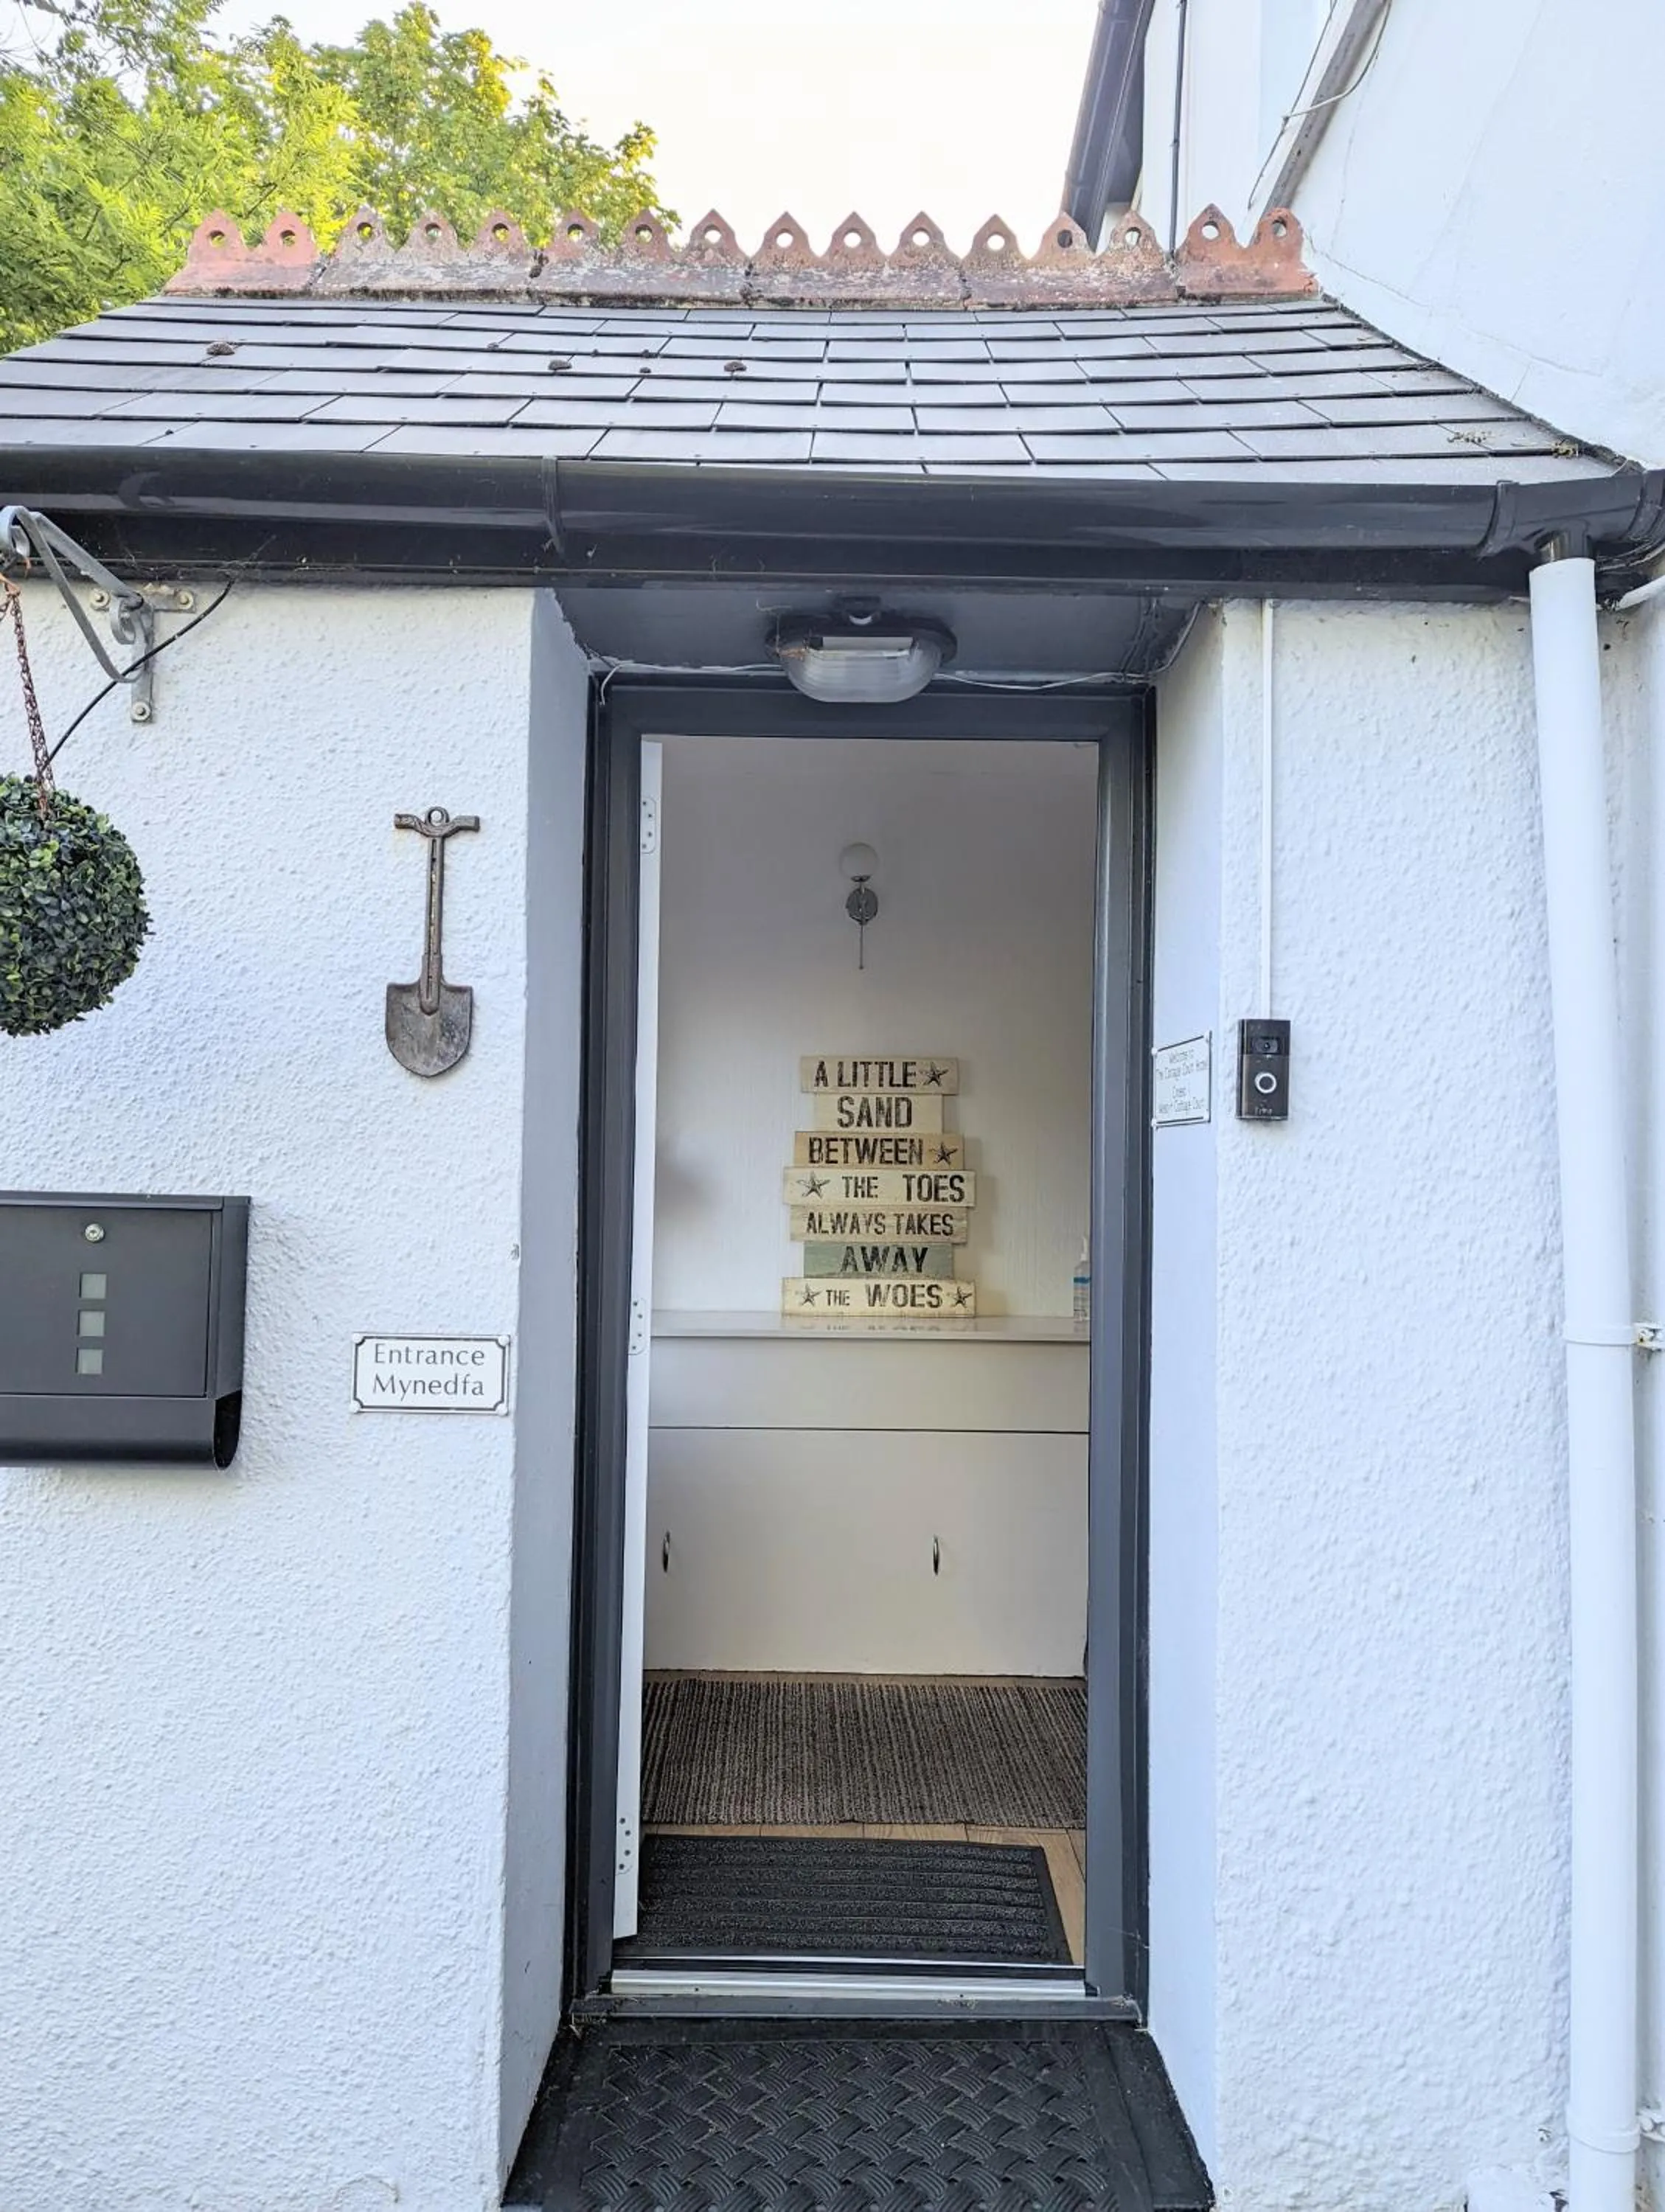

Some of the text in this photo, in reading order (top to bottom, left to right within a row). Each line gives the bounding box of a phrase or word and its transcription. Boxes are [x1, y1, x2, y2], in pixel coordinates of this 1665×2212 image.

[813, 1060, 917, 1088] A LITTLE
[837, 1096, 913, 1129] SAND
[808, 1137, 924, 1165] BETWEEN
[841, 1174, 965, 1203] THE TOES
[806, 1211, 954, 1237] ALWAYS TAKES
[840, 1245, 928, 1273] AWAY
[825, 1284, 943, 1309] THE WOES
[375, 1343, 485, 1366] Entrance
[372, 1373, 485, 1402] Mynedfa
